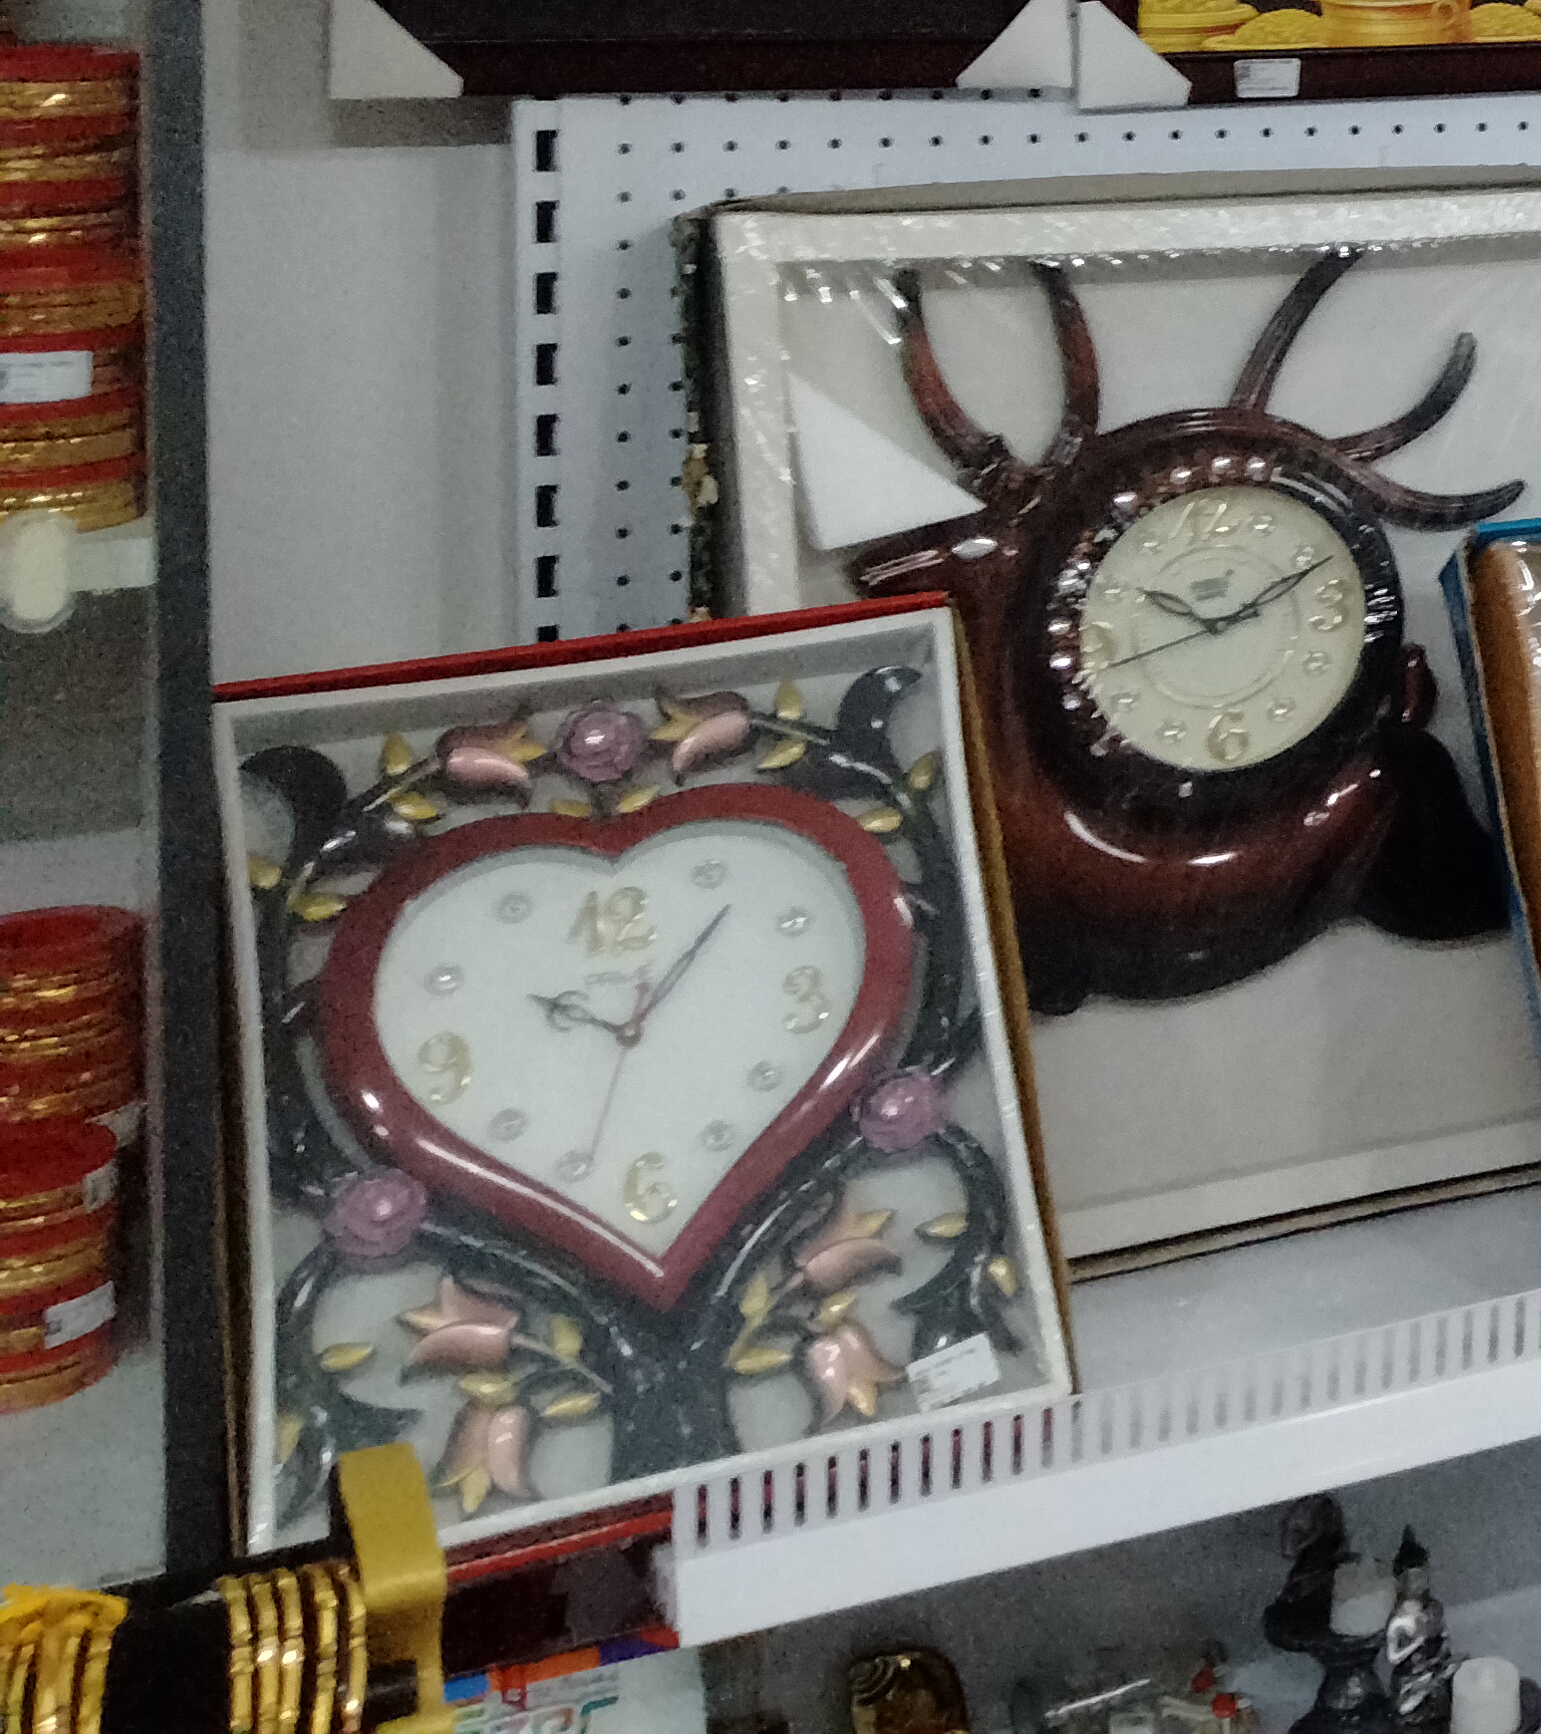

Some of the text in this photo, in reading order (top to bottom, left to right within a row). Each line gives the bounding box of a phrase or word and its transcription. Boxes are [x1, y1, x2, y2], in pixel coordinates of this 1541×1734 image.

[1207, 710, 1248, 762] 6
[567, 887, 658, 956] 12
[782, 965, 832, 1035] 3
[416, 1031, 472, 1105] 9
[622, 1150, 679, 1224] 6
